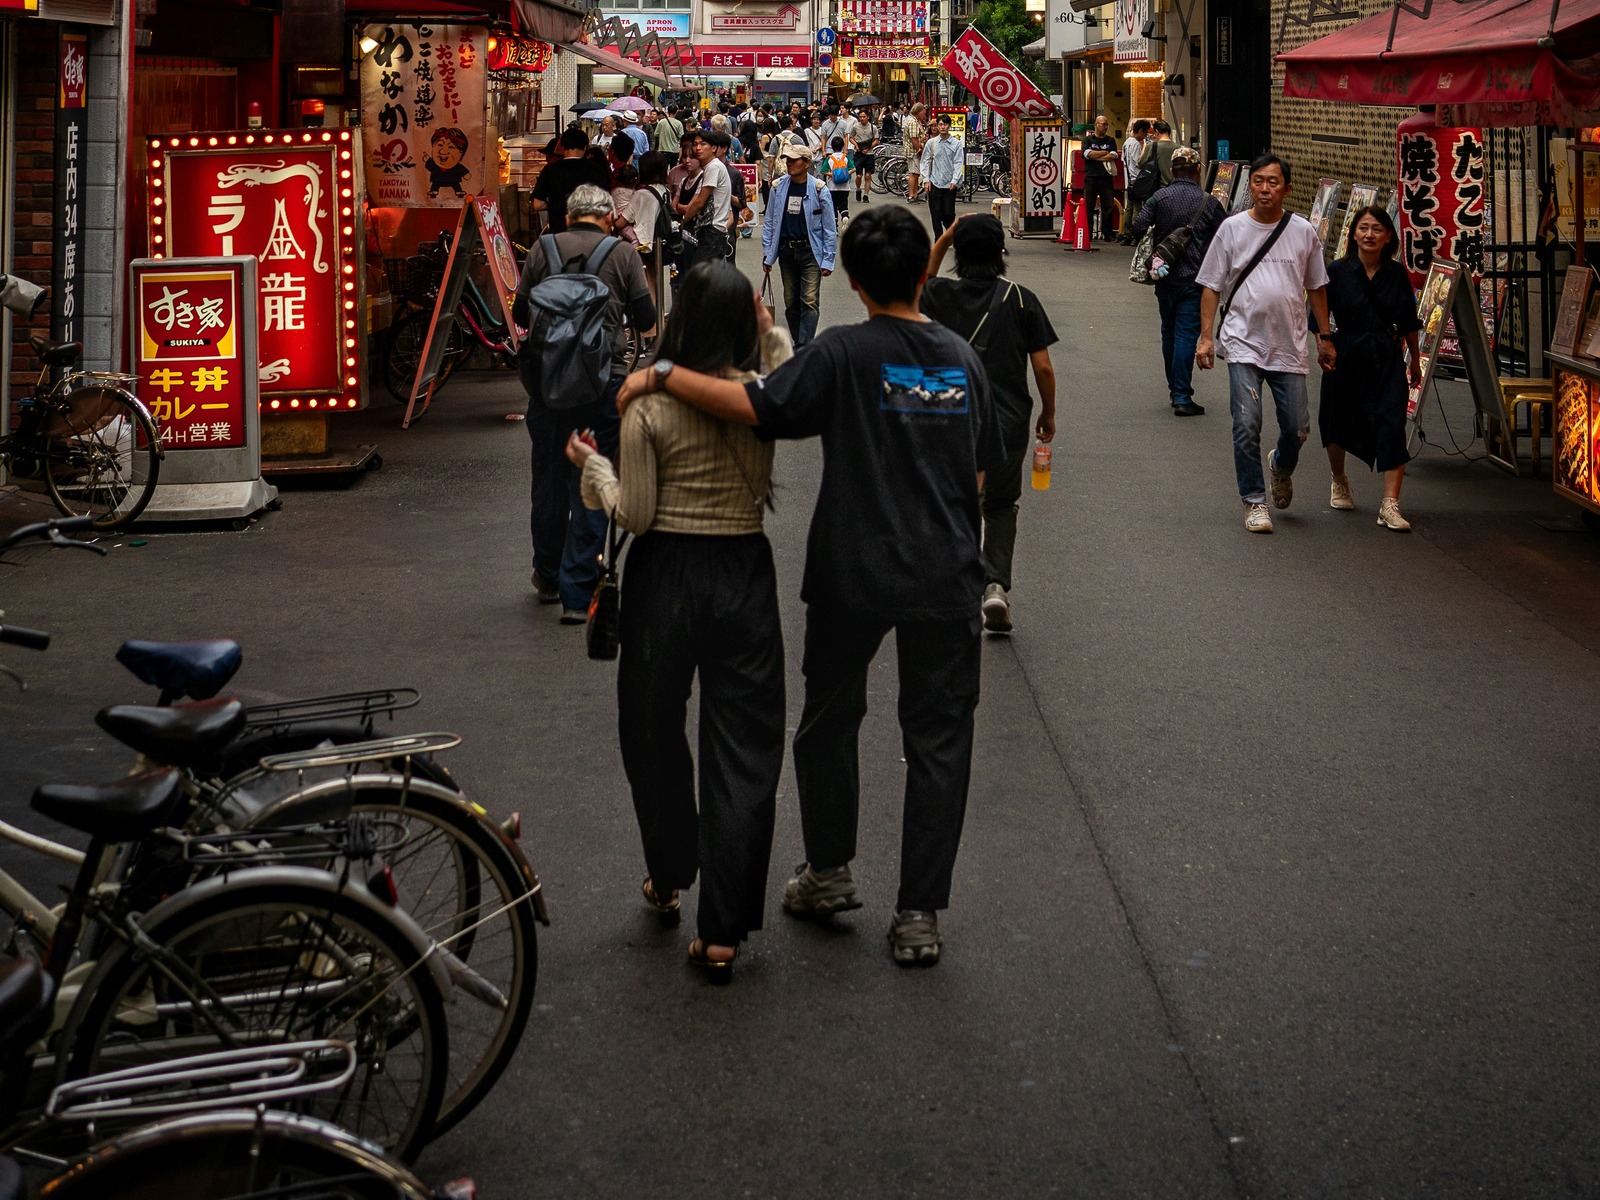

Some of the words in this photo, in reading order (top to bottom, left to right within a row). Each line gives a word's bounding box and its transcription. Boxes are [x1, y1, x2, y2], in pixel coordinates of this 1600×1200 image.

[457, 28, 476, 70] まいど
[712, 54, 744, 66] たばこ
[771, 54, 794, 66] 白衣
[857, 47, 925, 60] 道具屋筋まつり
[373, 27, 415, 136] わなか
[413, 23, 437, 128] たこ焼道楽
[378, 179, 410, 187] TAKOYAKI
[1030, 132, 1057, 211] 射的
[378, 188, 411, 199] WANAKA
[1400, 132, 1445, 275] 焼そば
[1450, 132, 1484, 278] たこ焼
[258, 197, 307, 332] 金龍
[149, 286, 225, 335] すき家
[170, 339, 205, 347] SUKIYA
[149, 366, 229, 393] 牛丼
[149, 396, 230, 421] カレー
[158, 421, 232, 443] 4H営業
